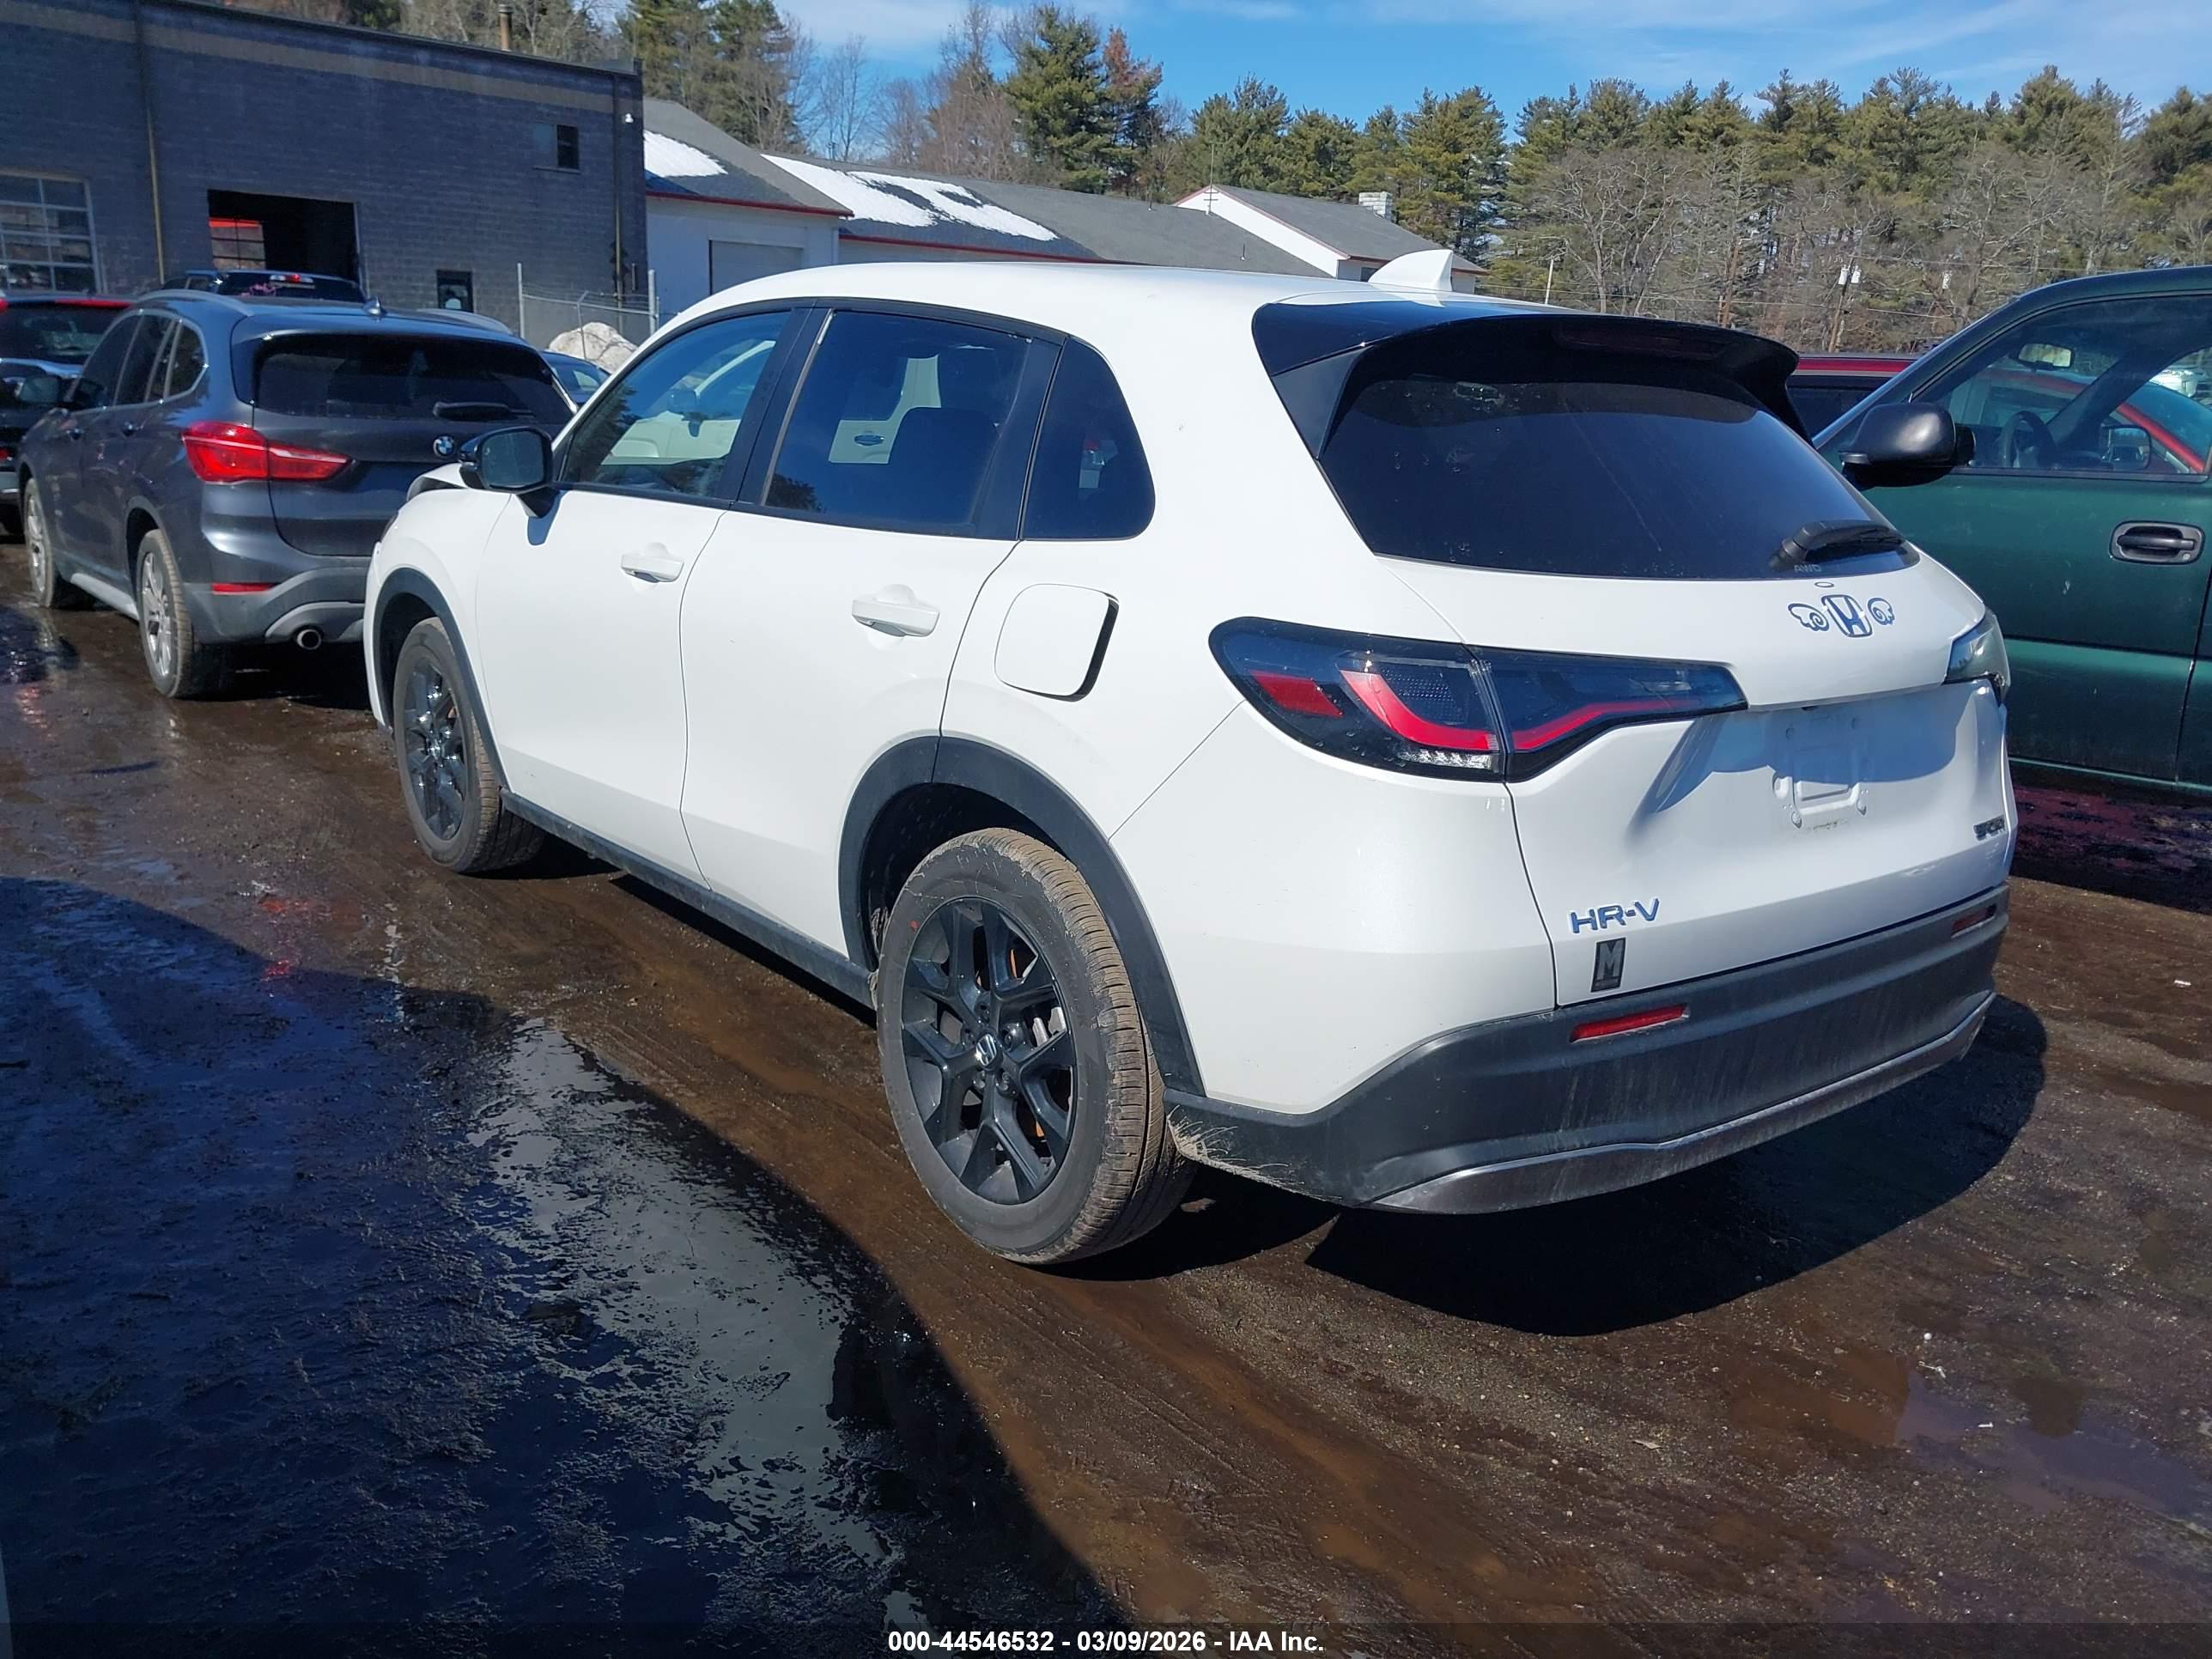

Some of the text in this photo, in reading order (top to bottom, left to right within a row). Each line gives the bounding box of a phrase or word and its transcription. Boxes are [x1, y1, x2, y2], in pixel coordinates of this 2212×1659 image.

[1793, 563, 1822, 574] AWD
[1570, 897, 1660, 934] HR-V
[1596, 939, 1623, 979] M
